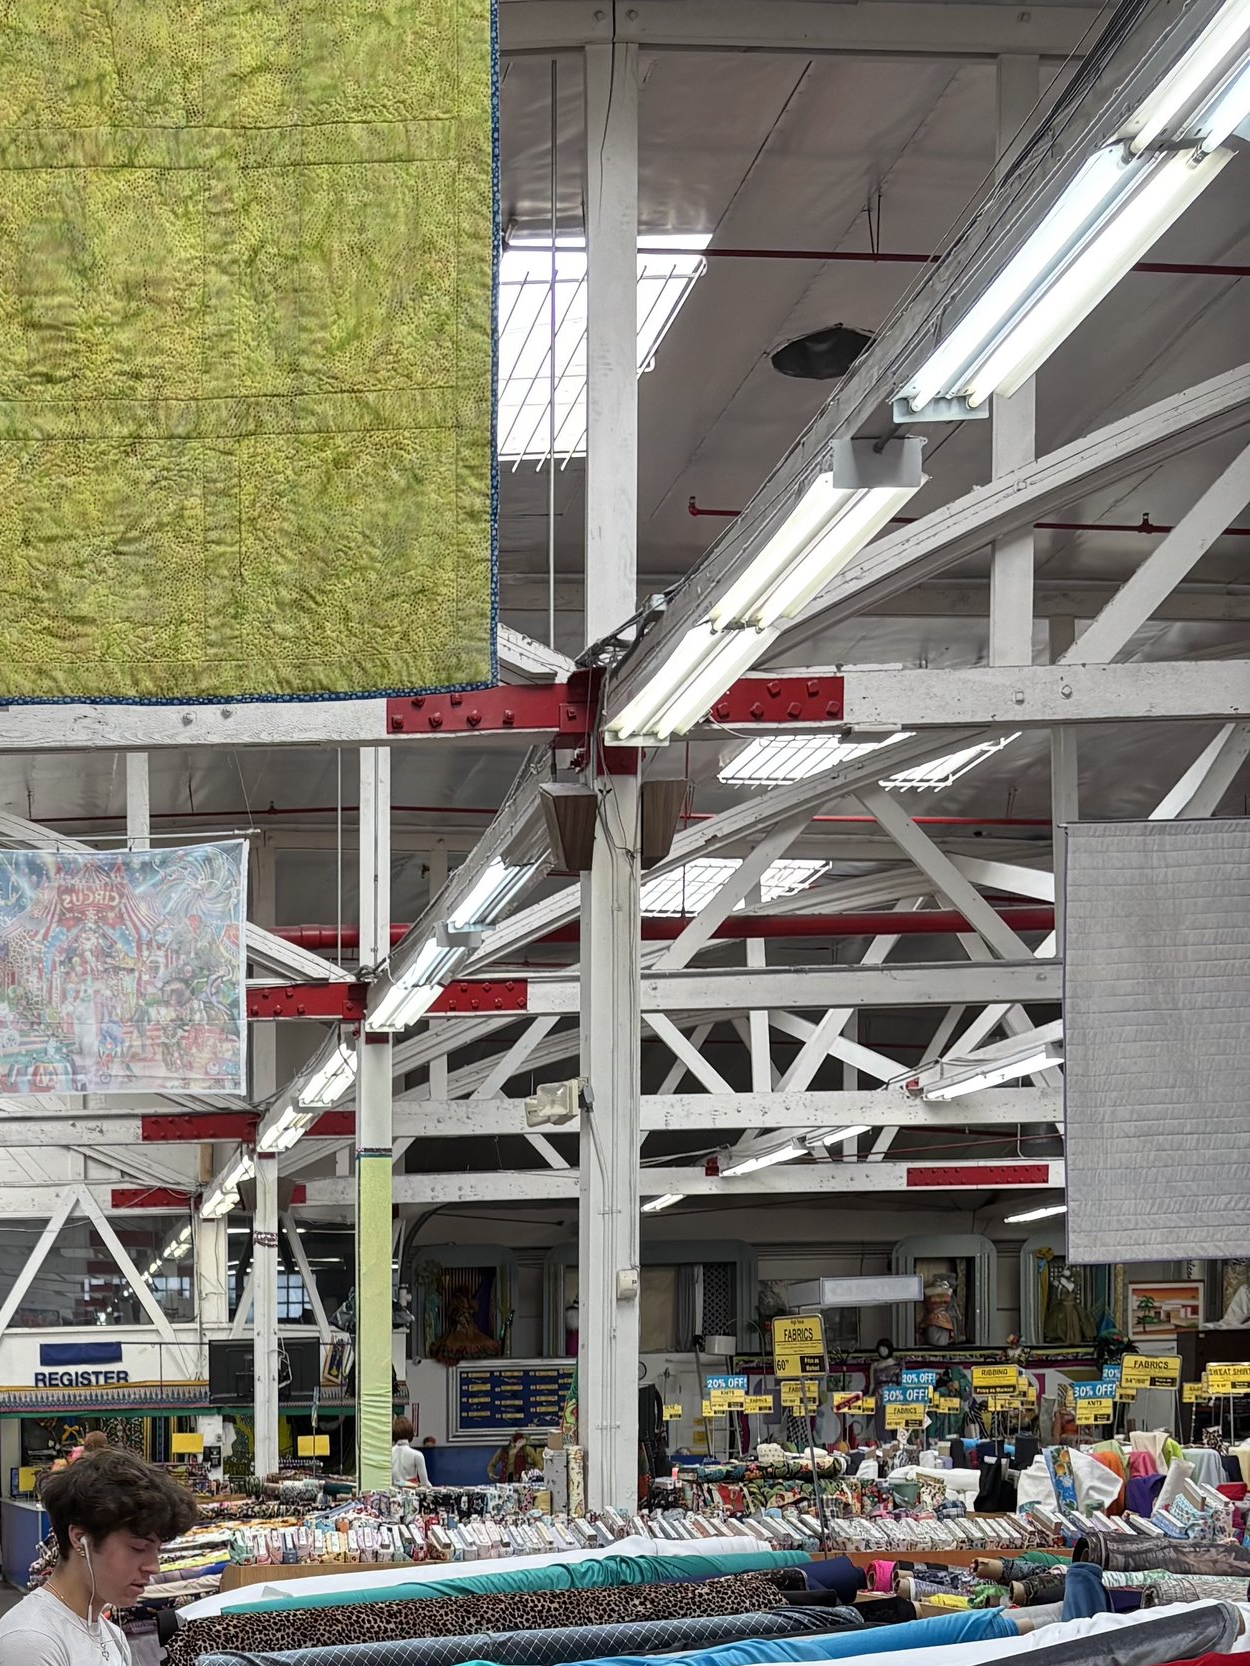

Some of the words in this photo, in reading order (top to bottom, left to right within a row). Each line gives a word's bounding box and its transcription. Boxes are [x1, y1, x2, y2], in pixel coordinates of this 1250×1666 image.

[784, 1328, 813, 1341] FABRICS
[1134, 1360, 1169, 1370] FABRICS
[34, 1370, 129, 1387] REGISTER
[707, 1379, 725, 1388] 20%
[728, 1377, 747, 1387] OFF!
[902, 1374, 918, 1382] 20%
[919, 1373, 936, 1382] OFF!
[884, 1391, 903, 1401] 30%
[906, 1389, 928, 1400] OFF!
[1074, 1386, 1093, 1398] 30%
[1096, 1384, 1116, 1395] OFF!
